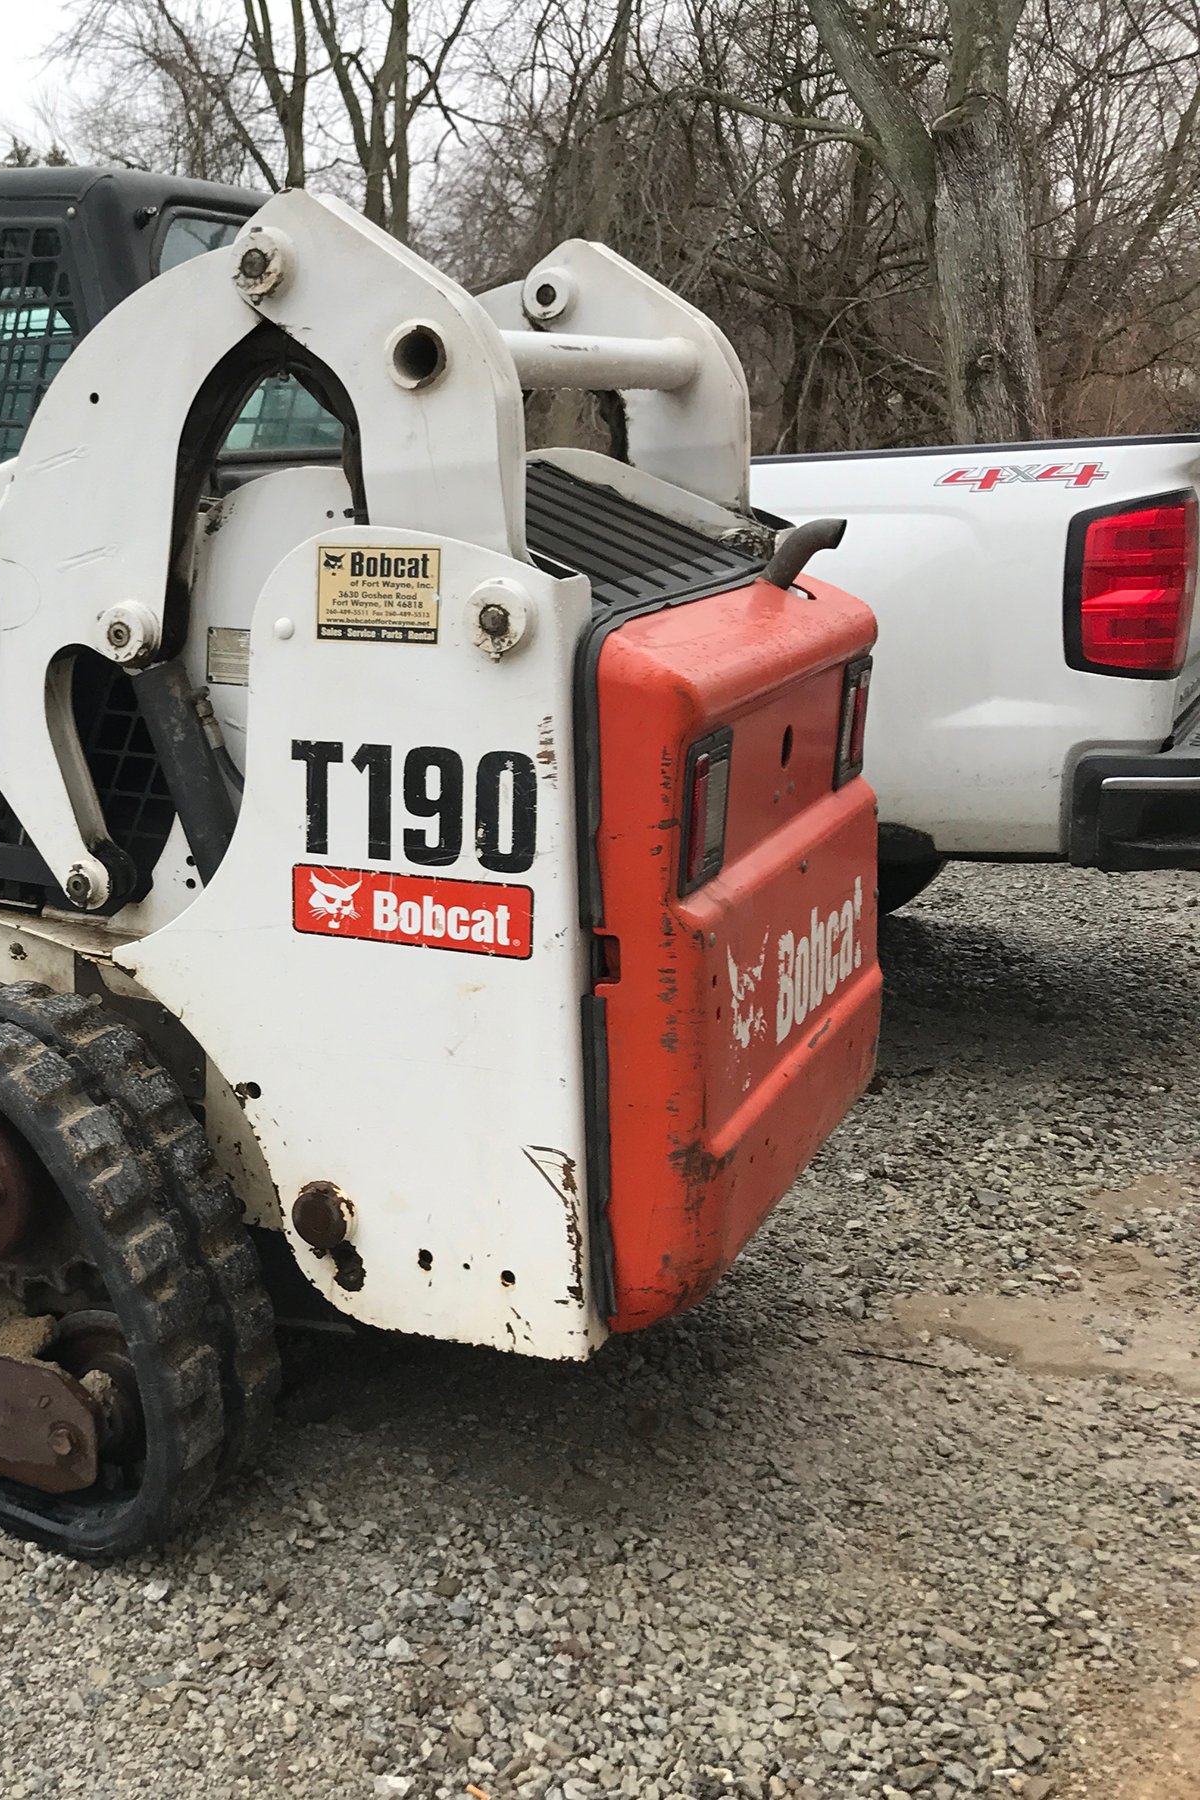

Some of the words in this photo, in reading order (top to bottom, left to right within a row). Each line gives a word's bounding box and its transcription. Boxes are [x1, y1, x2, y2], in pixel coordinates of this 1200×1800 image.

[350, 551, 431, 579] Bobcat
[362, 580, 380, 588] Fort
[382, 581, 414, 590] Wayne,
[417, 581, 434, 589] Inc.
[338, 590, 359, 599] 3630
[361, 591, 393, 600] Goshen
[395, 592, 417, 601] Road
[332, 598, 349, 607] Fort
[351, 600, 382, 609] Wayne,
[397, 601, 424, 609] 46818
[321, 627, 342, 637] Sales
[347, 628, 376, 638] Service
[381, 629, 403, 639] Parts
[408, 631, 435, 640] Rental
[291, 739, 538, 874] T190
[373, 889, 511, 946] Bobcat
